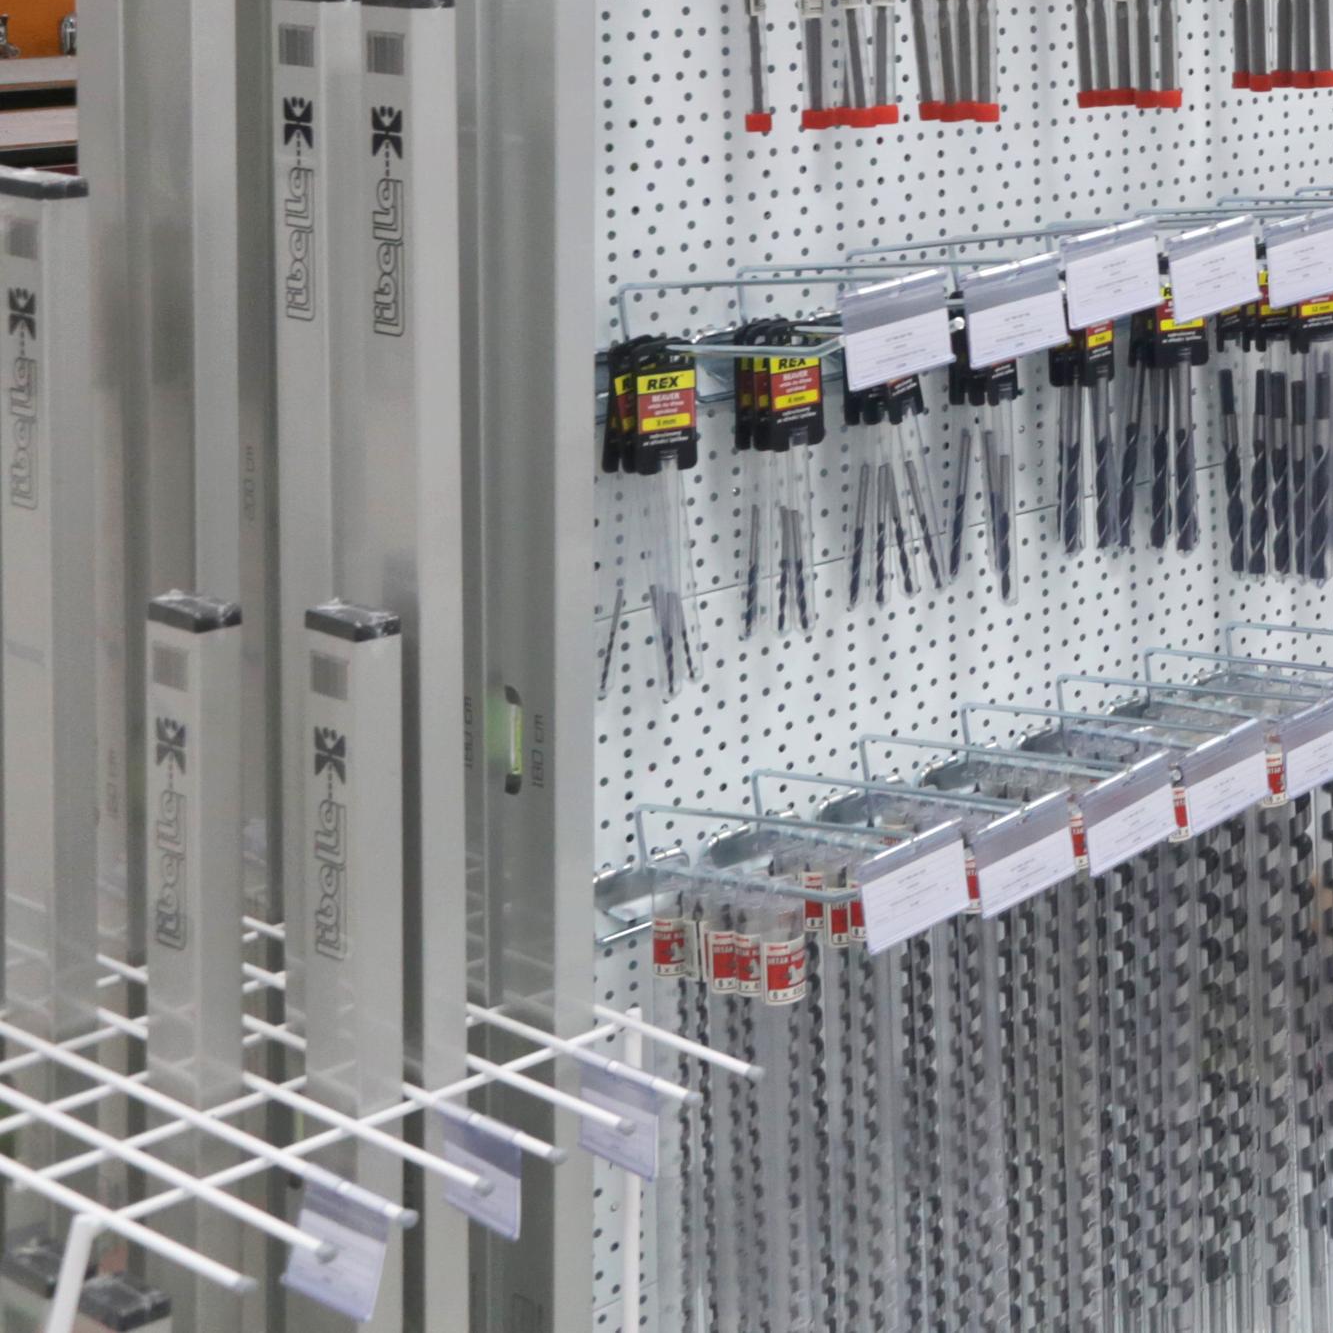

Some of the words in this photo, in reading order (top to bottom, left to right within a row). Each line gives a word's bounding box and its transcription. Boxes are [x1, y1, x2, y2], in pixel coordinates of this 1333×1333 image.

[778, 357, 808, 371] REX
[647, 376, 679, 391] REX
[652, 392, 681, 402] BEAVER
